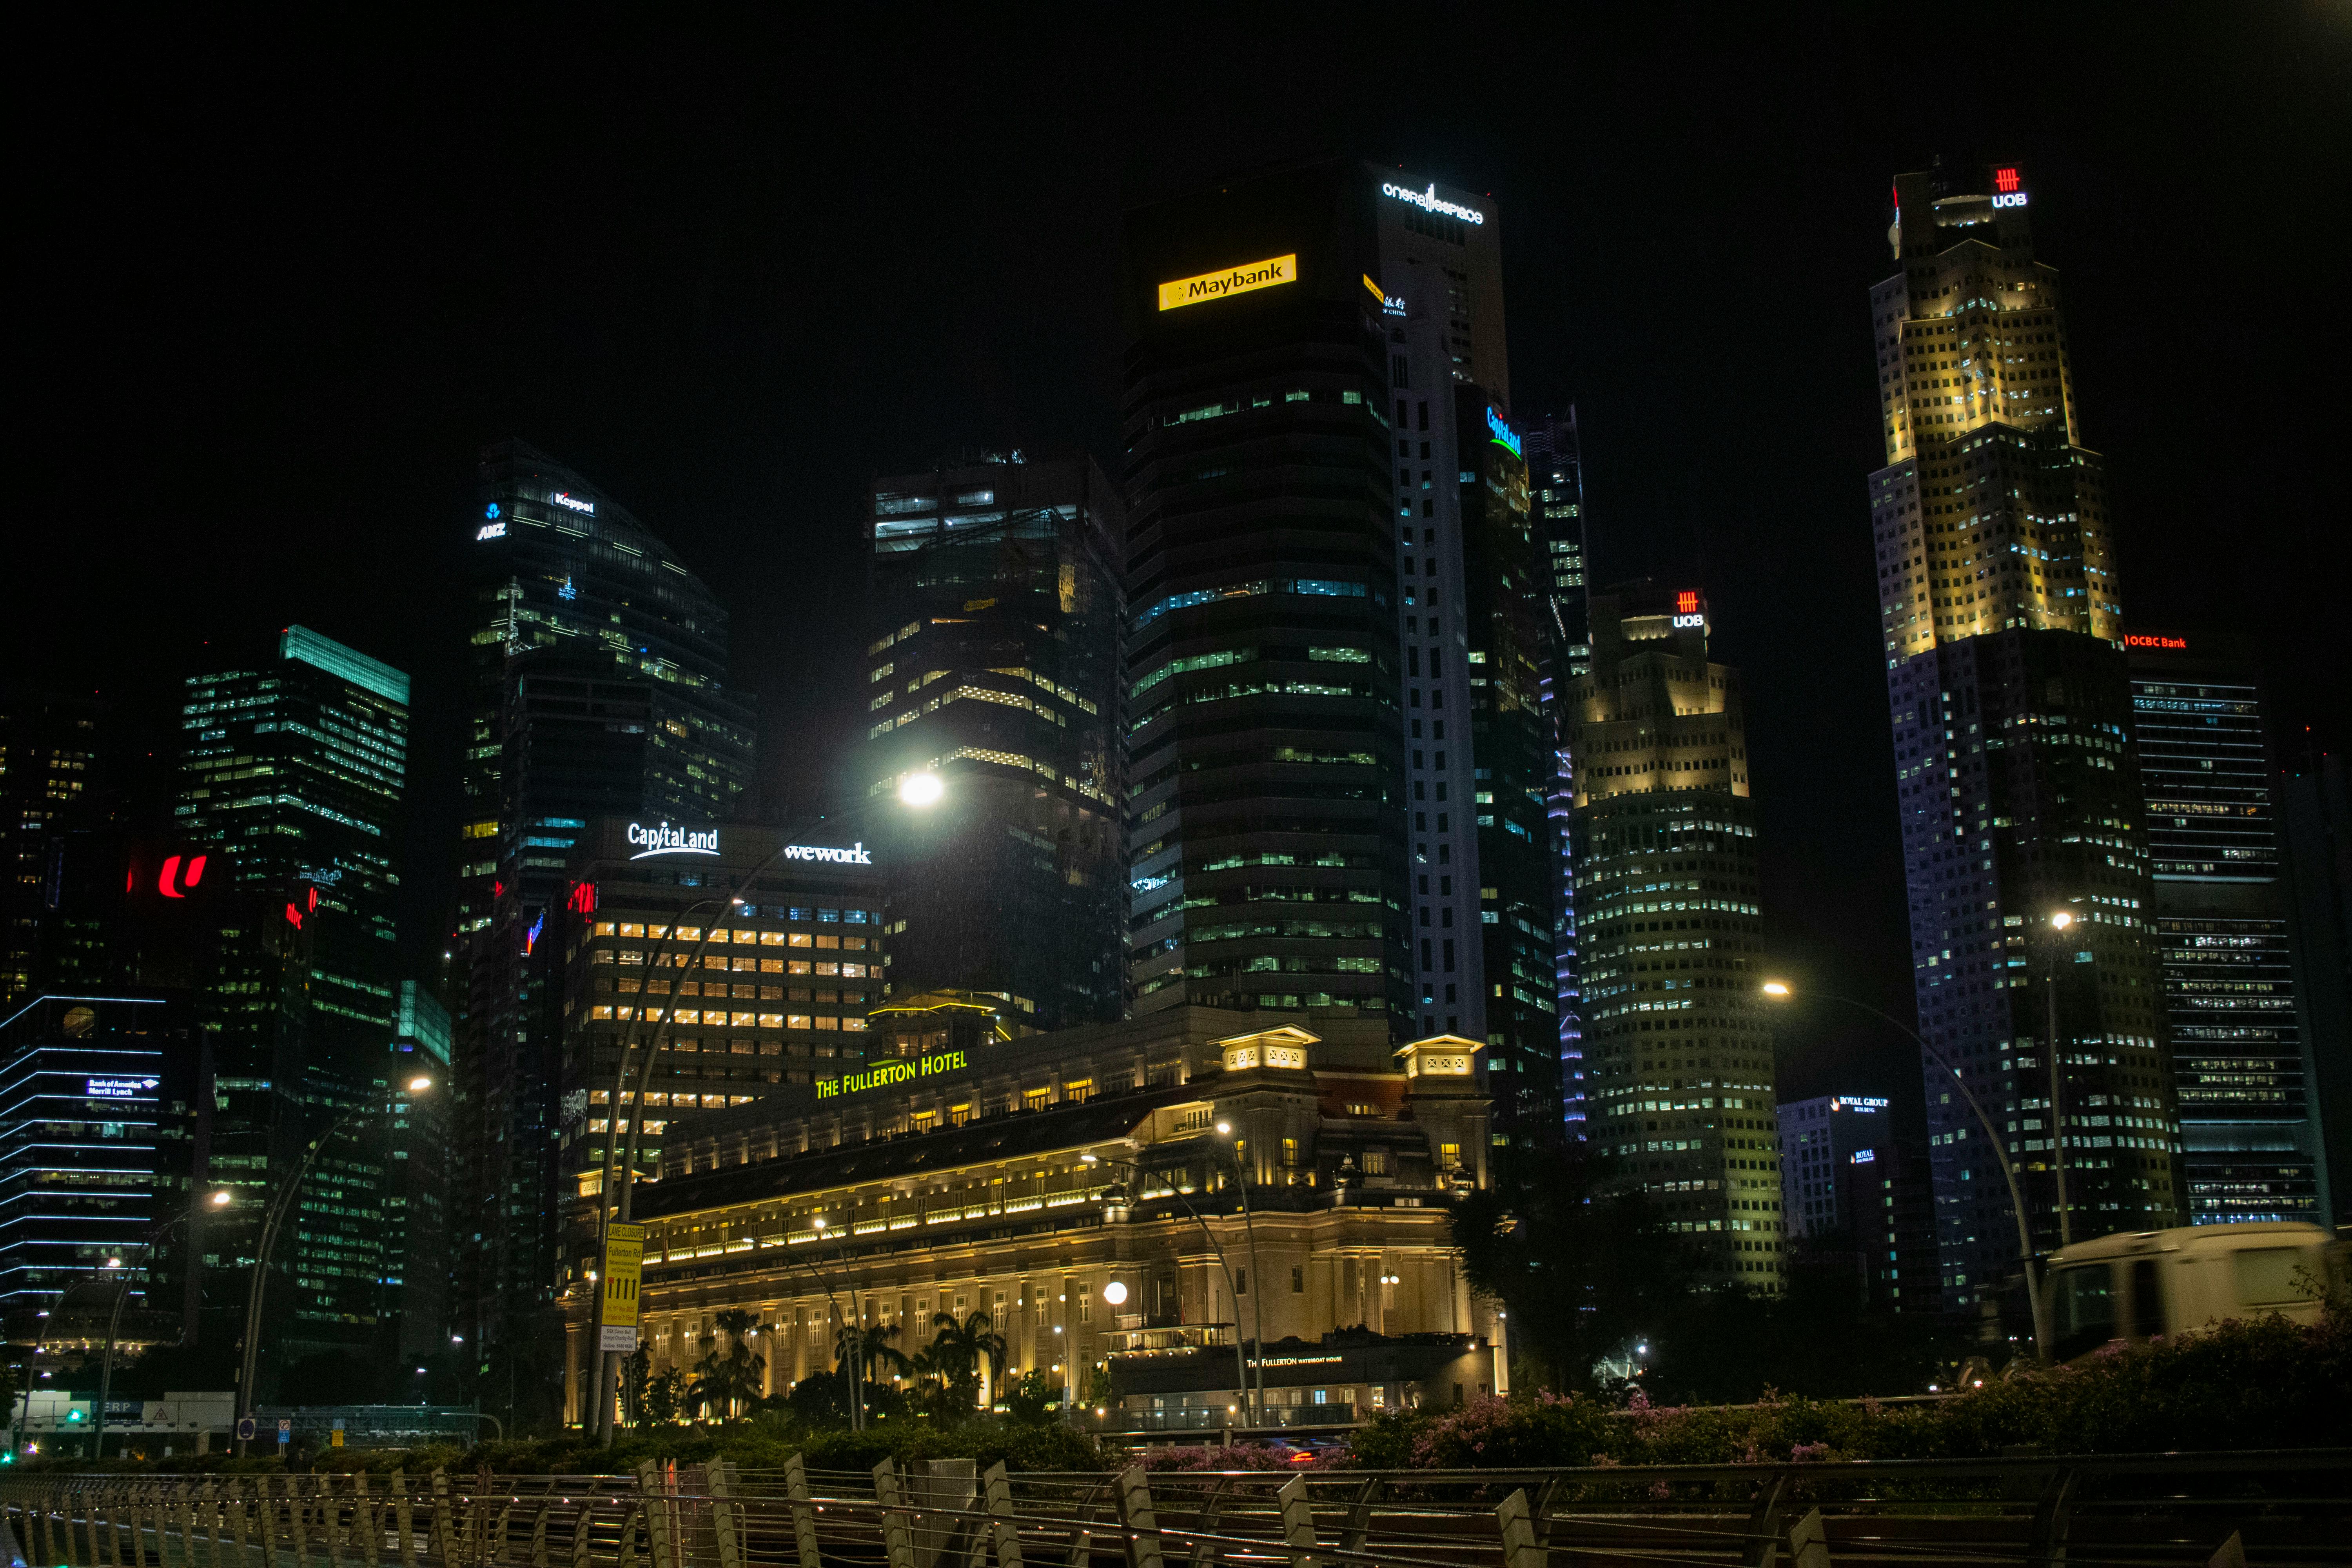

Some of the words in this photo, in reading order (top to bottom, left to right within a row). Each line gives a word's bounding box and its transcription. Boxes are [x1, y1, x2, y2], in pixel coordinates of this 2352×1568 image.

[1992, 193, 2027, 208] UOB
[1189, 263, 1283, 298] Maybank
[1368, 281, 1383, 299] Maybank
[1487, 406, 1521, 455] CapitaLand
[555, 492, 594, 513] Keppel
[477, 523, 506, 541] ANZ
[1673, 614, 1704, 628] UOB
[2130, 635, 2159, 647] OCBC
[2161, 637, 2186, 648] Bank
[628, 822, 718, 850] CapitaLand
[784, 842, 872, 864] wework
[816, 1080, 838, 1099] THE
[844, 1062, 916, 1094] FULLERTON
[922, 1051, 967, 1076] HOTEL
[1840, 1097, 1863, 1106] ROYAL
[1864, 1098, 1888, 1107] GROUP
[1855, 1149, 1874, 1159] ROYAL
[609, 1226, 621, 1236] LANE
[622, 1227, 643, 1238] CLOSURE
[609, 1247, 632, 1257] Fullerton
[633, 1248, 641, 1258] Rd
[1247, 1359, 1257, 1368] TH
[1261, 1357, 1297, 1367] FULLERTON
[105, 1402, 131, 1412] ERP
